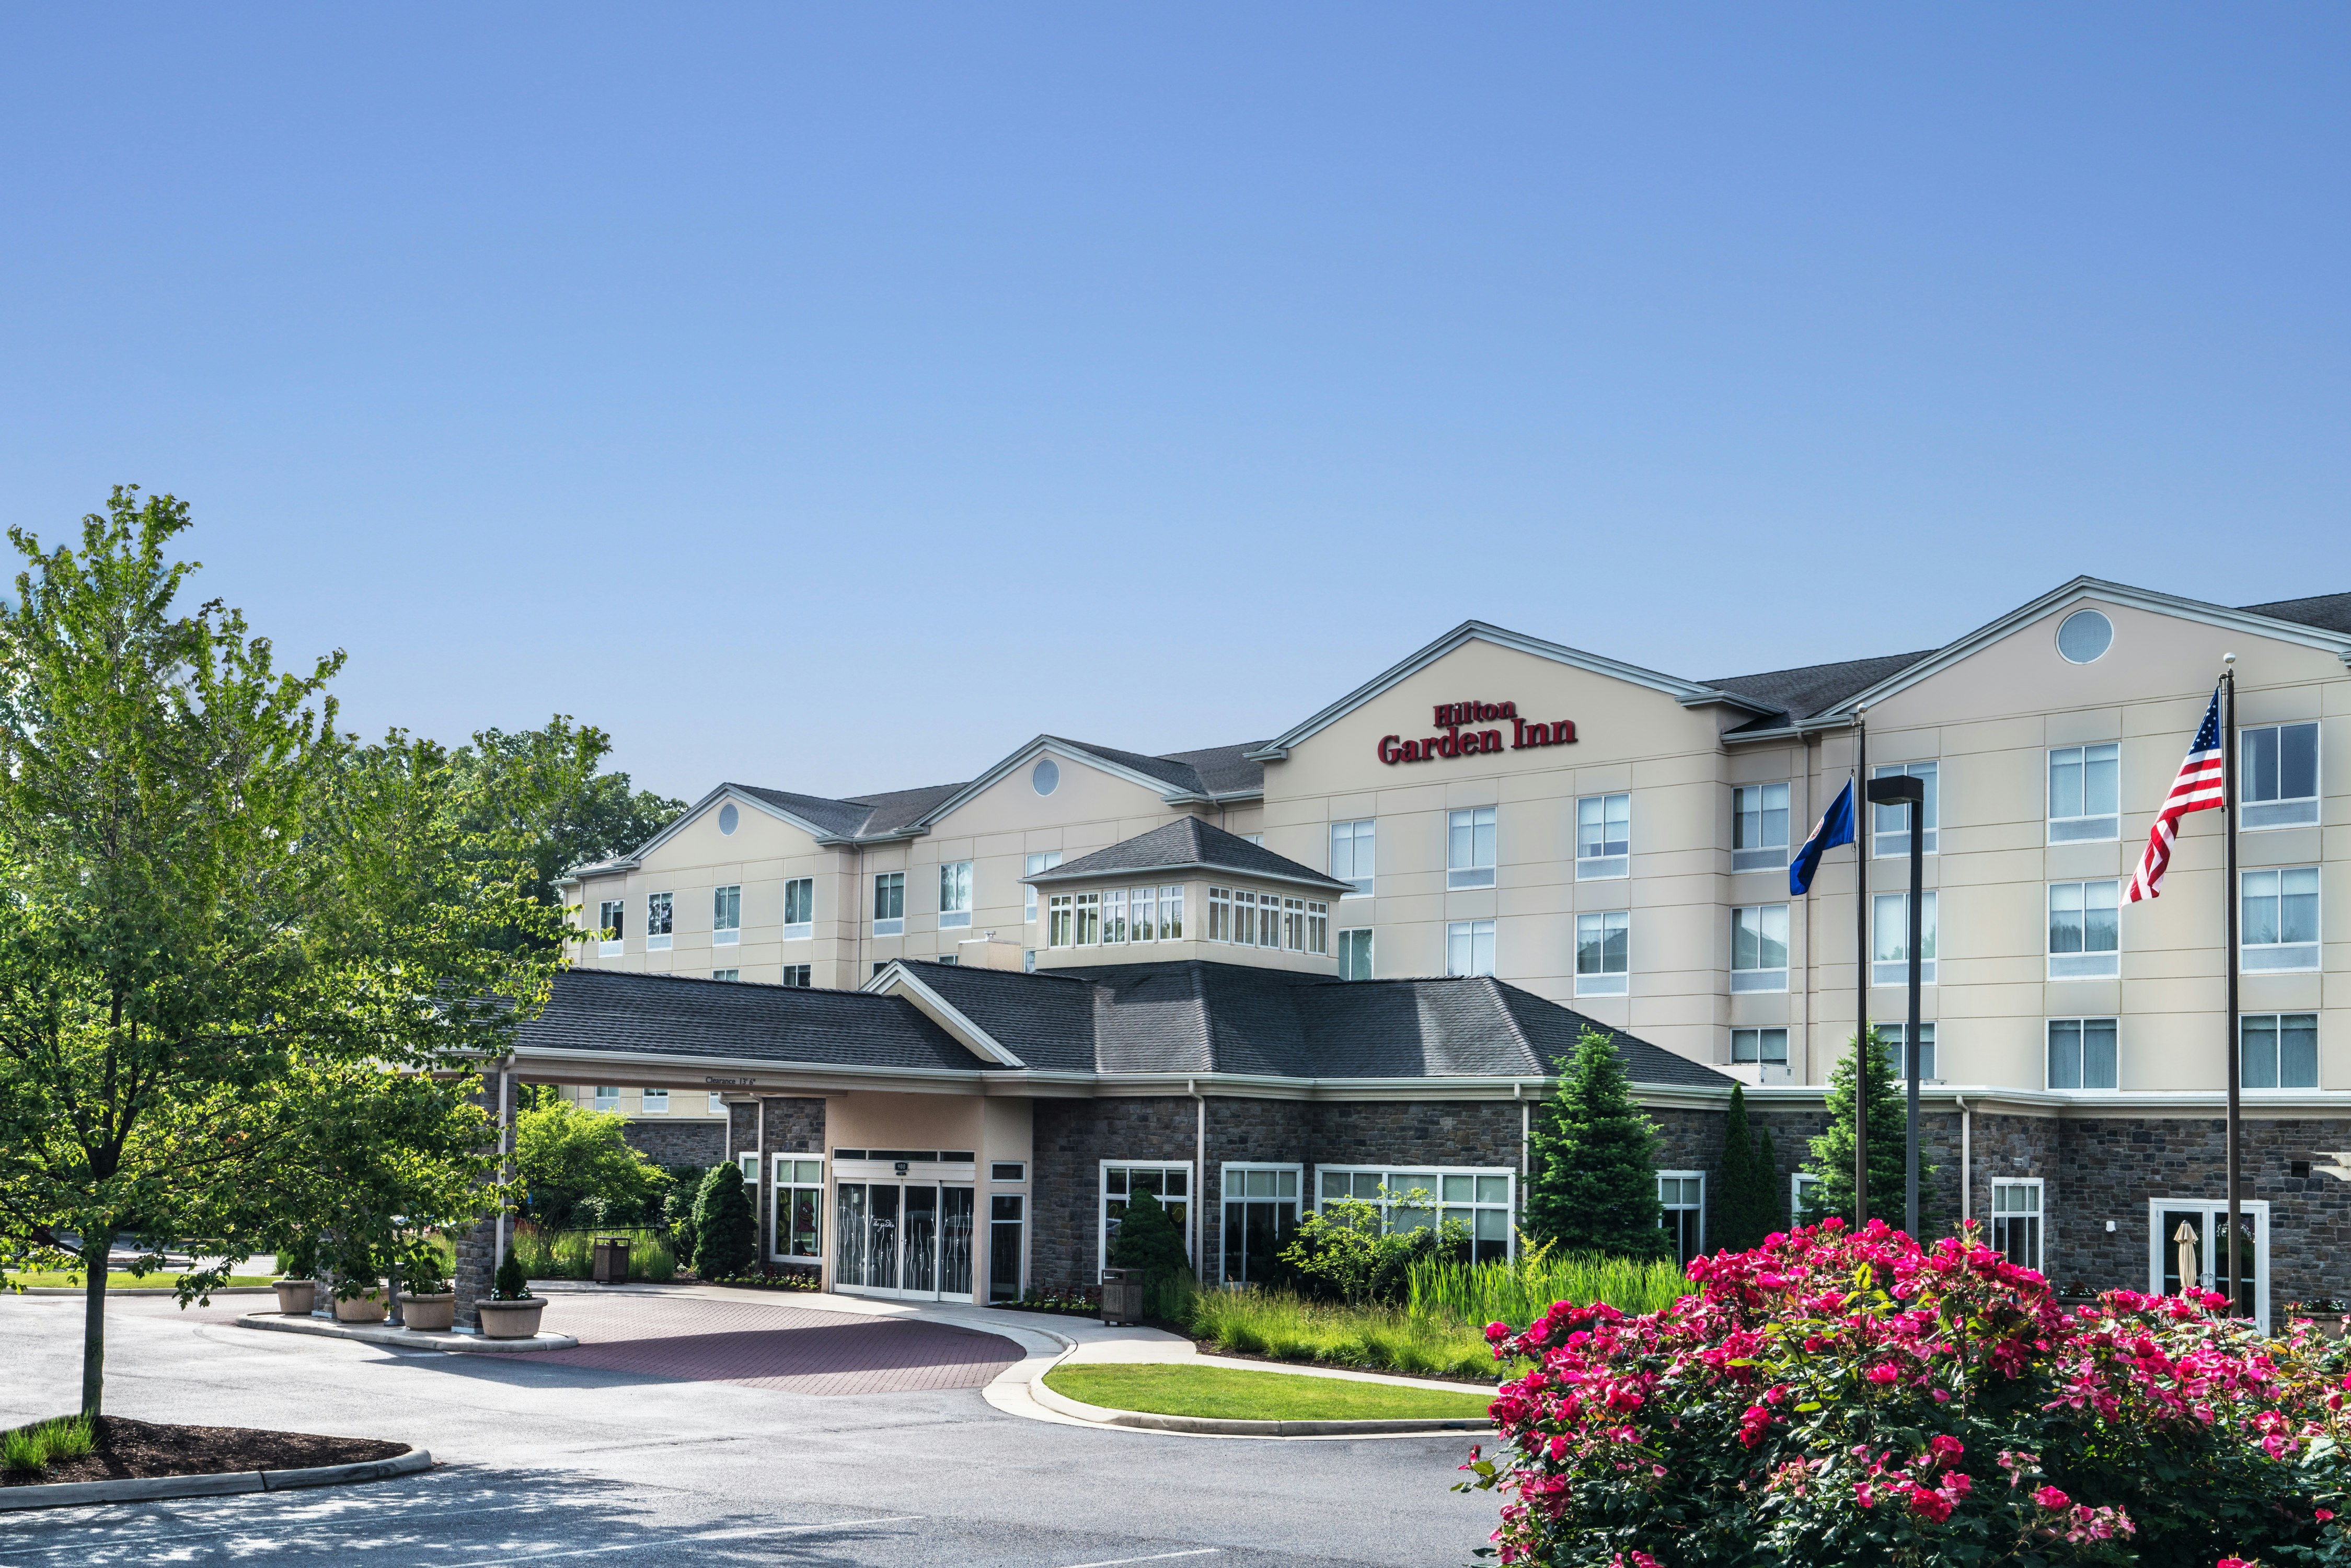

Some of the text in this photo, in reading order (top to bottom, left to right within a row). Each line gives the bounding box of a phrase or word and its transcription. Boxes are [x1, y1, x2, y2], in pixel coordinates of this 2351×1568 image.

[1433, 700, 1517, 727] Hilton
[1378, 718, 1578, 765] Garden Inn
[878, 1219, 895, 1232] garden
